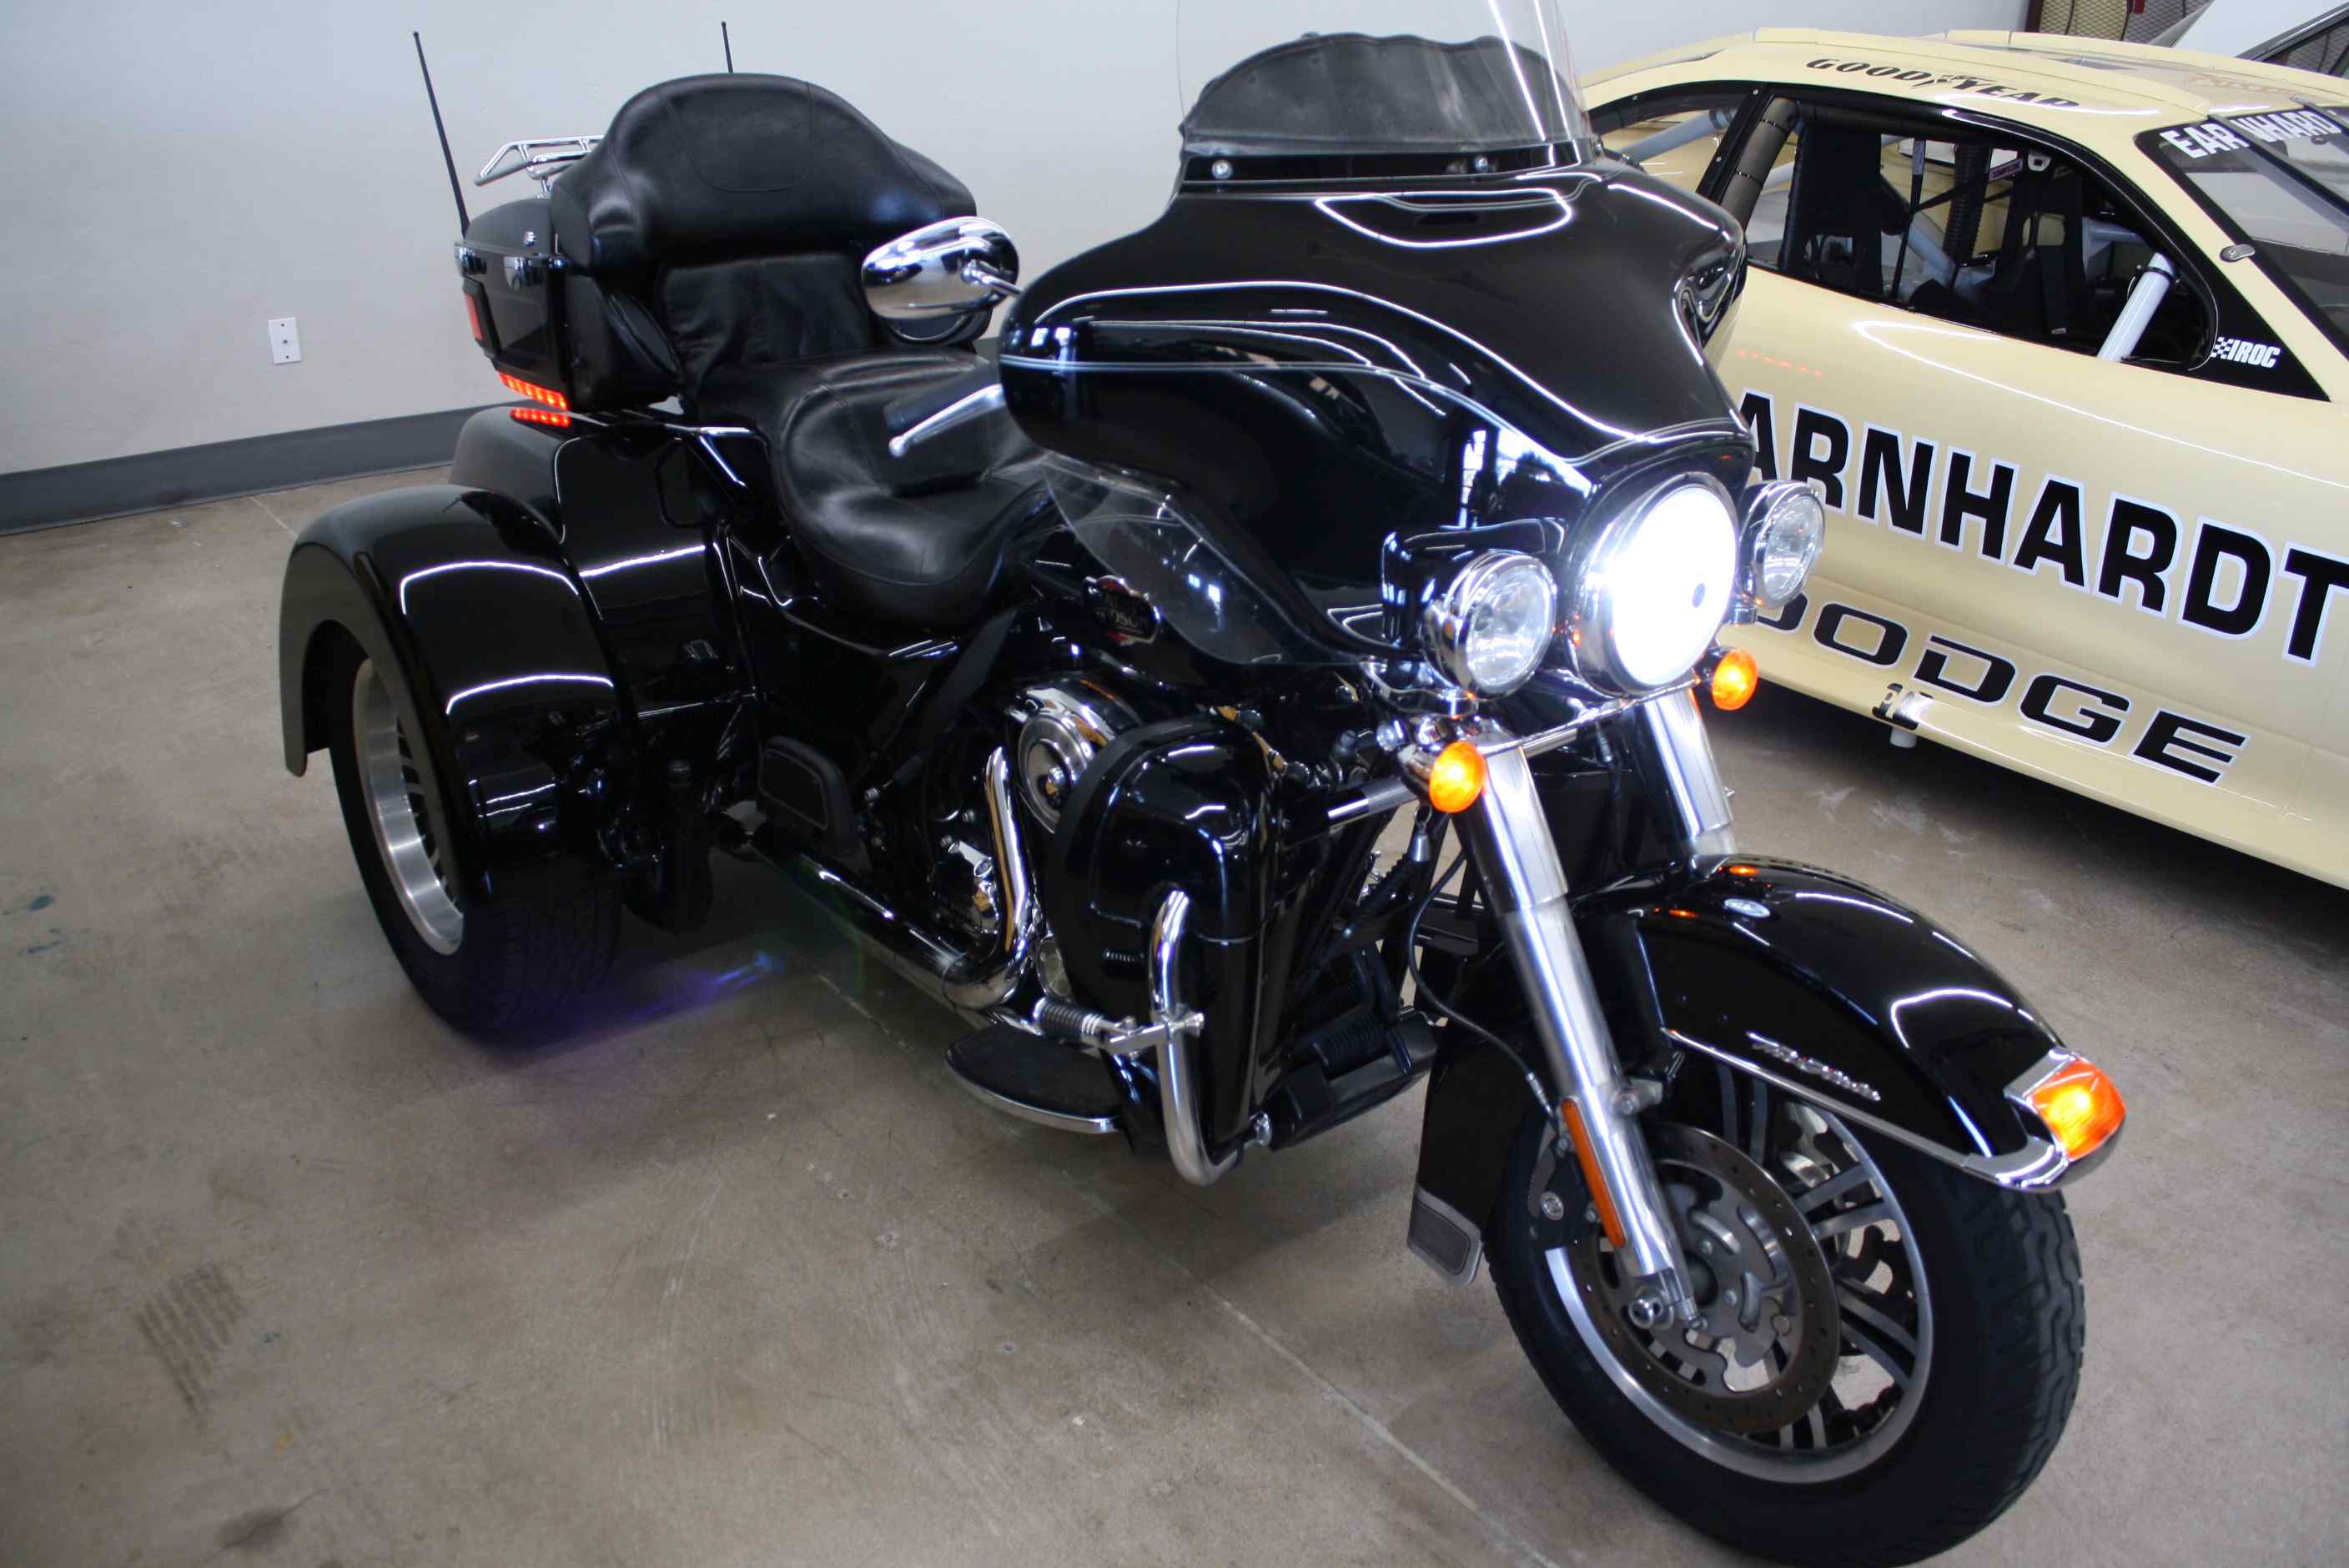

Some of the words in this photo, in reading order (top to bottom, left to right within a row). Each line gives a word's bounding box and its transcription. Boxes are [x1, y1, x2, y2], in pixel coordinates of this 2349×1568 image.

[2160, 109, 2337, 158] EARNHARD
[2226, 339, 2281, 368] IROC
[1738, 387, 2349, 667] ARNHARDT
